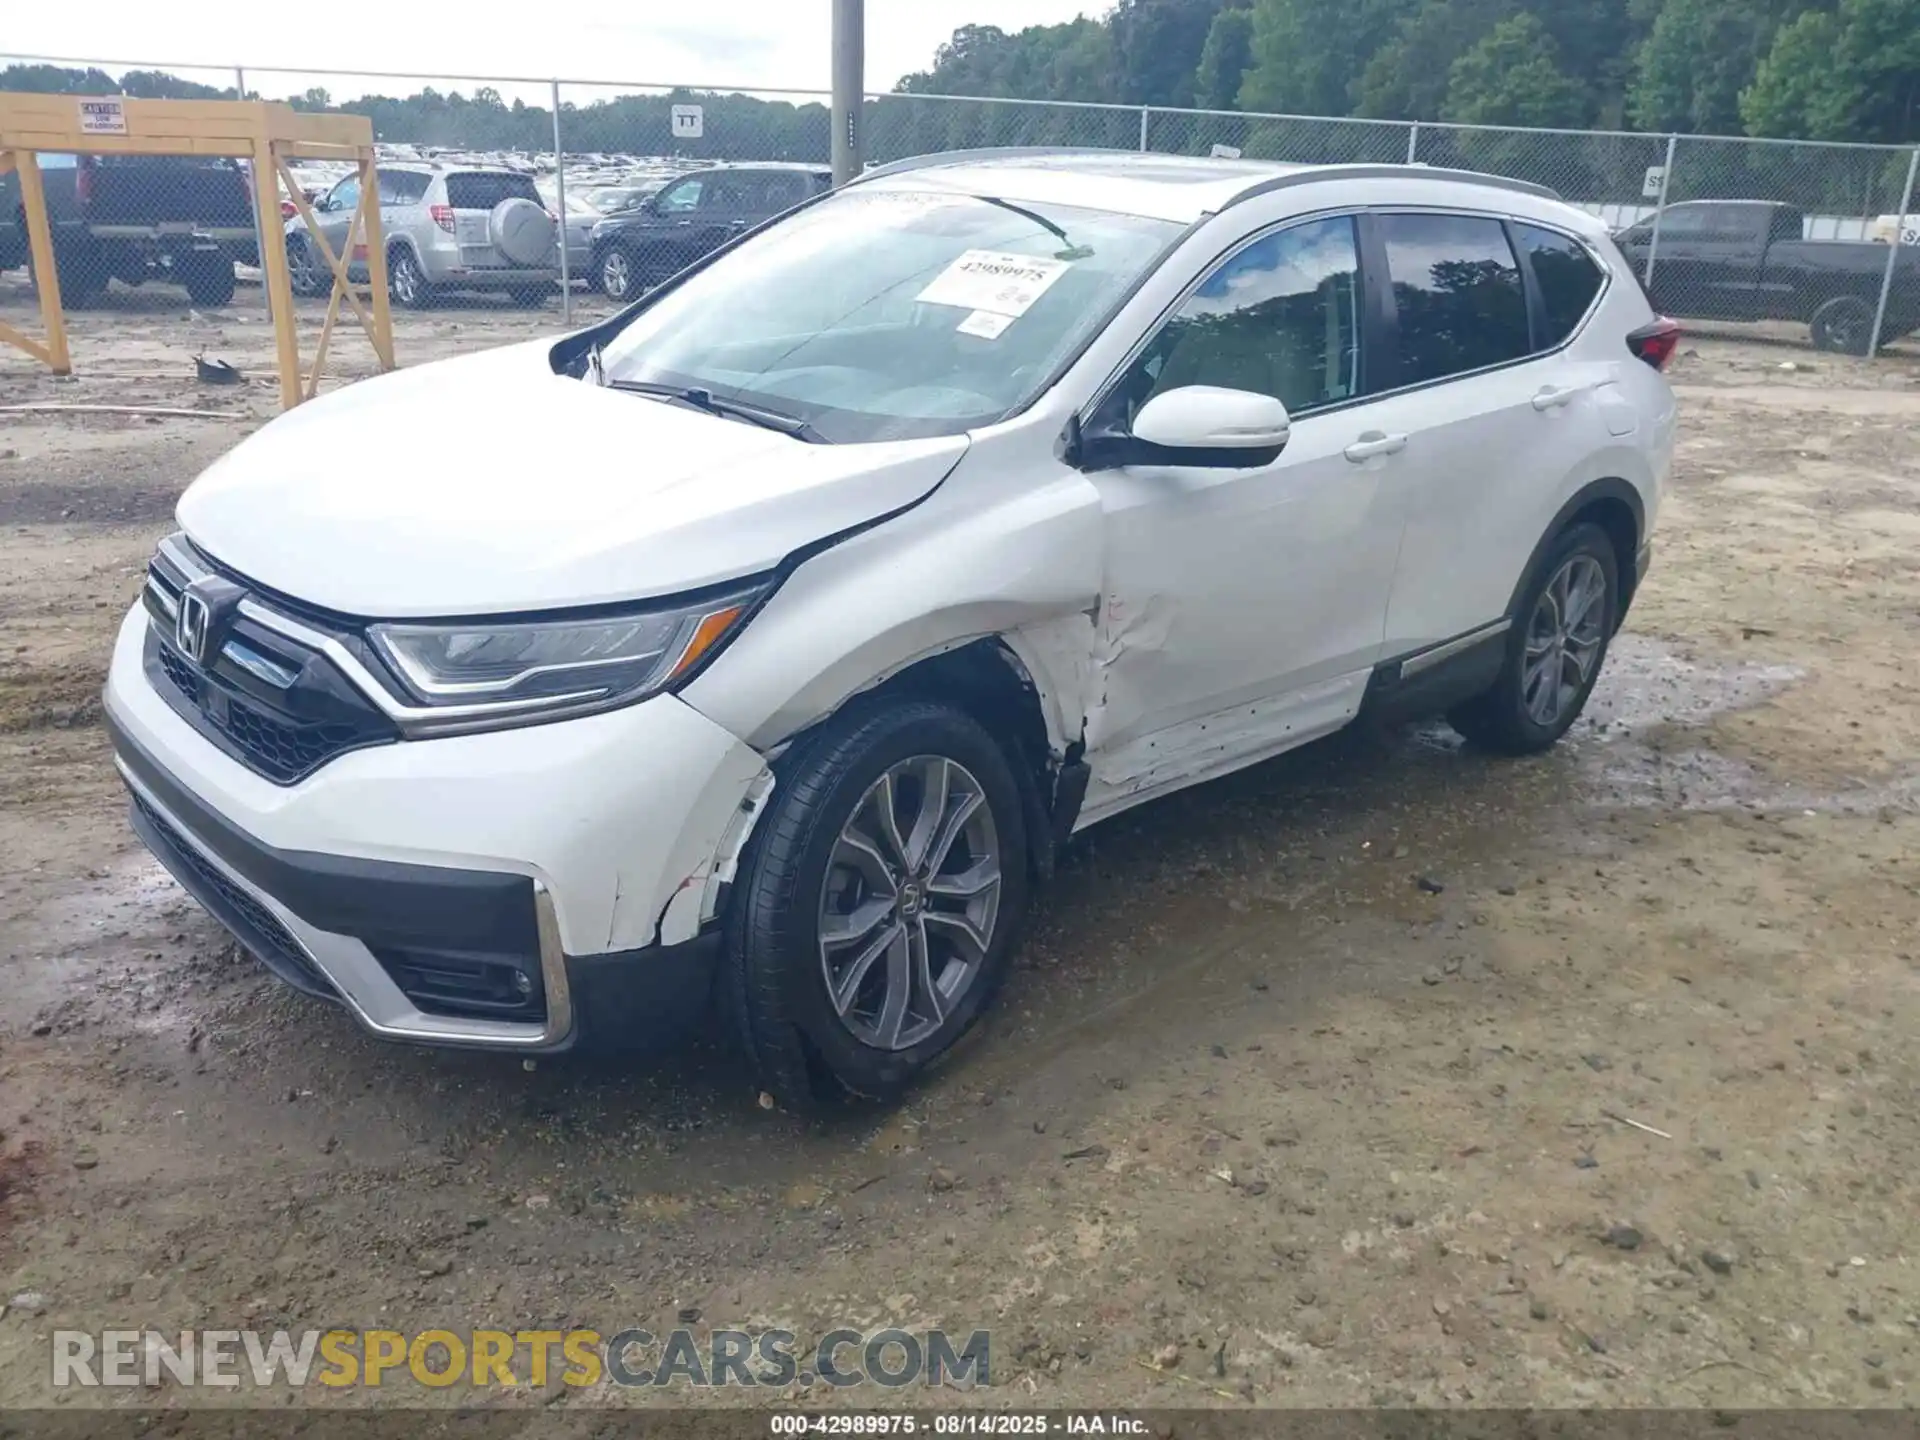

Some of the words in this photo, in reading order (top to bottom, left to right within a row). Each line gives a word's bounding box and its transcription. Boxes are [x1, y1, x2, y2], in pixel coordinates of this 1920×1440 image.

[82, 103, 121, 114] CAUTION
[676, 114, 698, 128] TT
[959, 262, 1048, 281] 42989975
